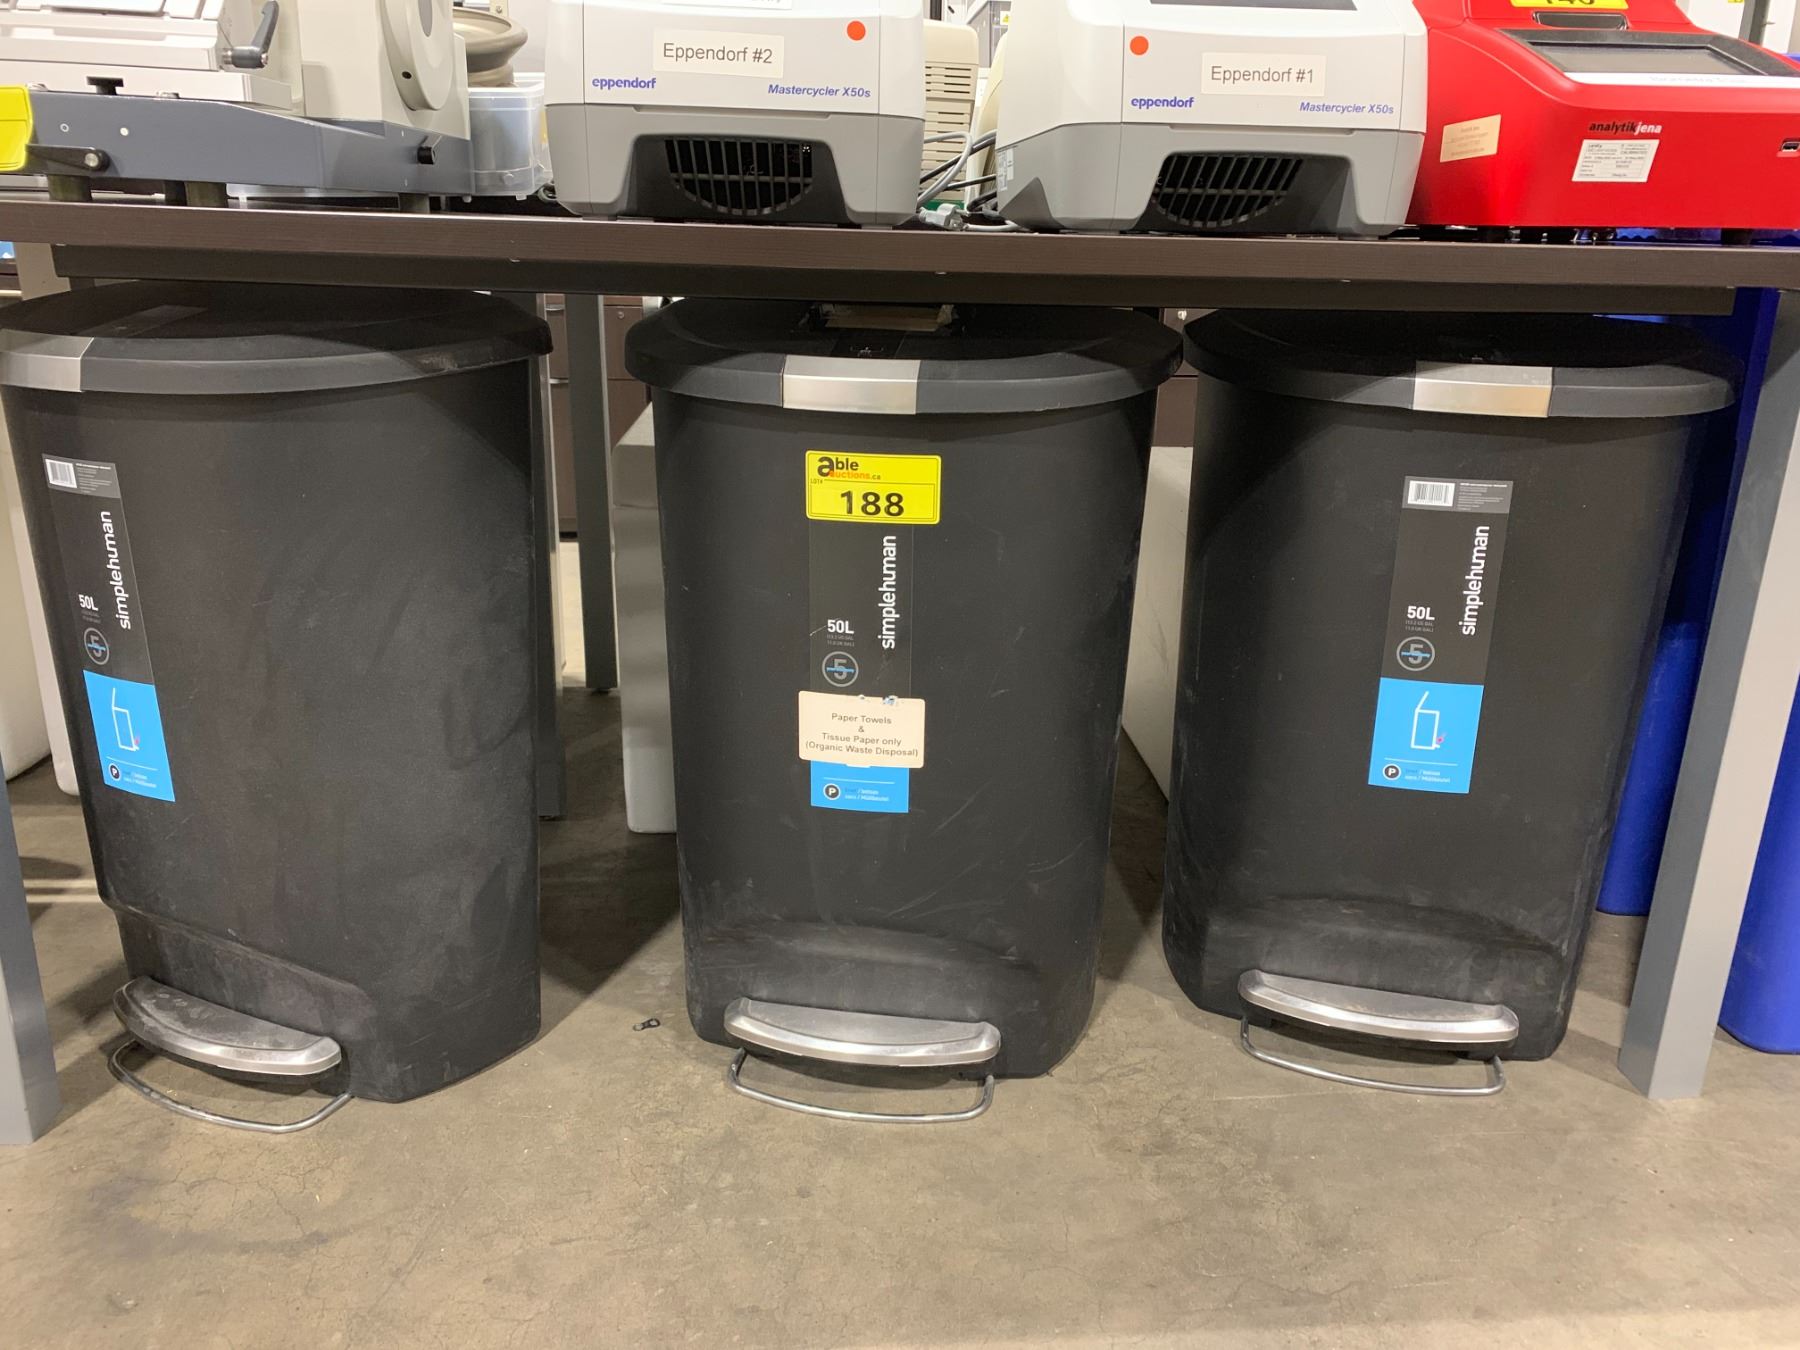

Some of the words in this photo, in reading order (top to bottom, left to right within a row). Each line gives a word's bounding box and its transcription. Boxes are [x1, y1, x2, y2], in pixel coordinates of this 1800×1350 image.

[663, 43, 748, 63] Eppendorf
[752, 49, 773, 64] #2
[1211, 66, 1291, 84] Eppendorf
[1296, 69, 1314, 83] #1
[592, 77, 657, 90] eppendorf
[768, 84, 839, 98] Mastercycler
[842, 87, 871, 98] X50s
[1131, 96, 1194, 109] eppendorf
[1300, 102, 1366, 114] Mastercycler
[1368, 104, 1394, 114] X50s
[817, 456, 859, 477] able
[830, 471, 881, 480] auctions.ca
[840, 490, 904, 517] 188
[101, 511, 131, 630] simplehuman
[1459, 526, 1490, 635] simplehuman
[878, 536, 900, 649] simplehuman
[79, 594, 99, 611] 50L
[1407, 605, 1435, 620] 50L
[827, 619, 854, 634] 50L
[831, 713, 858, 723] Paper
[860, 715, 892, 724] Towels
[822, 733, 850, 742] Tissue
[853, 736, 880, 745] Paper
[882, 738, 902, 746] only
[805, 741, 843, 751] (Organic
[846, 745, 873, 754] Waste
[875, 747, 919, 757] Disposal)
